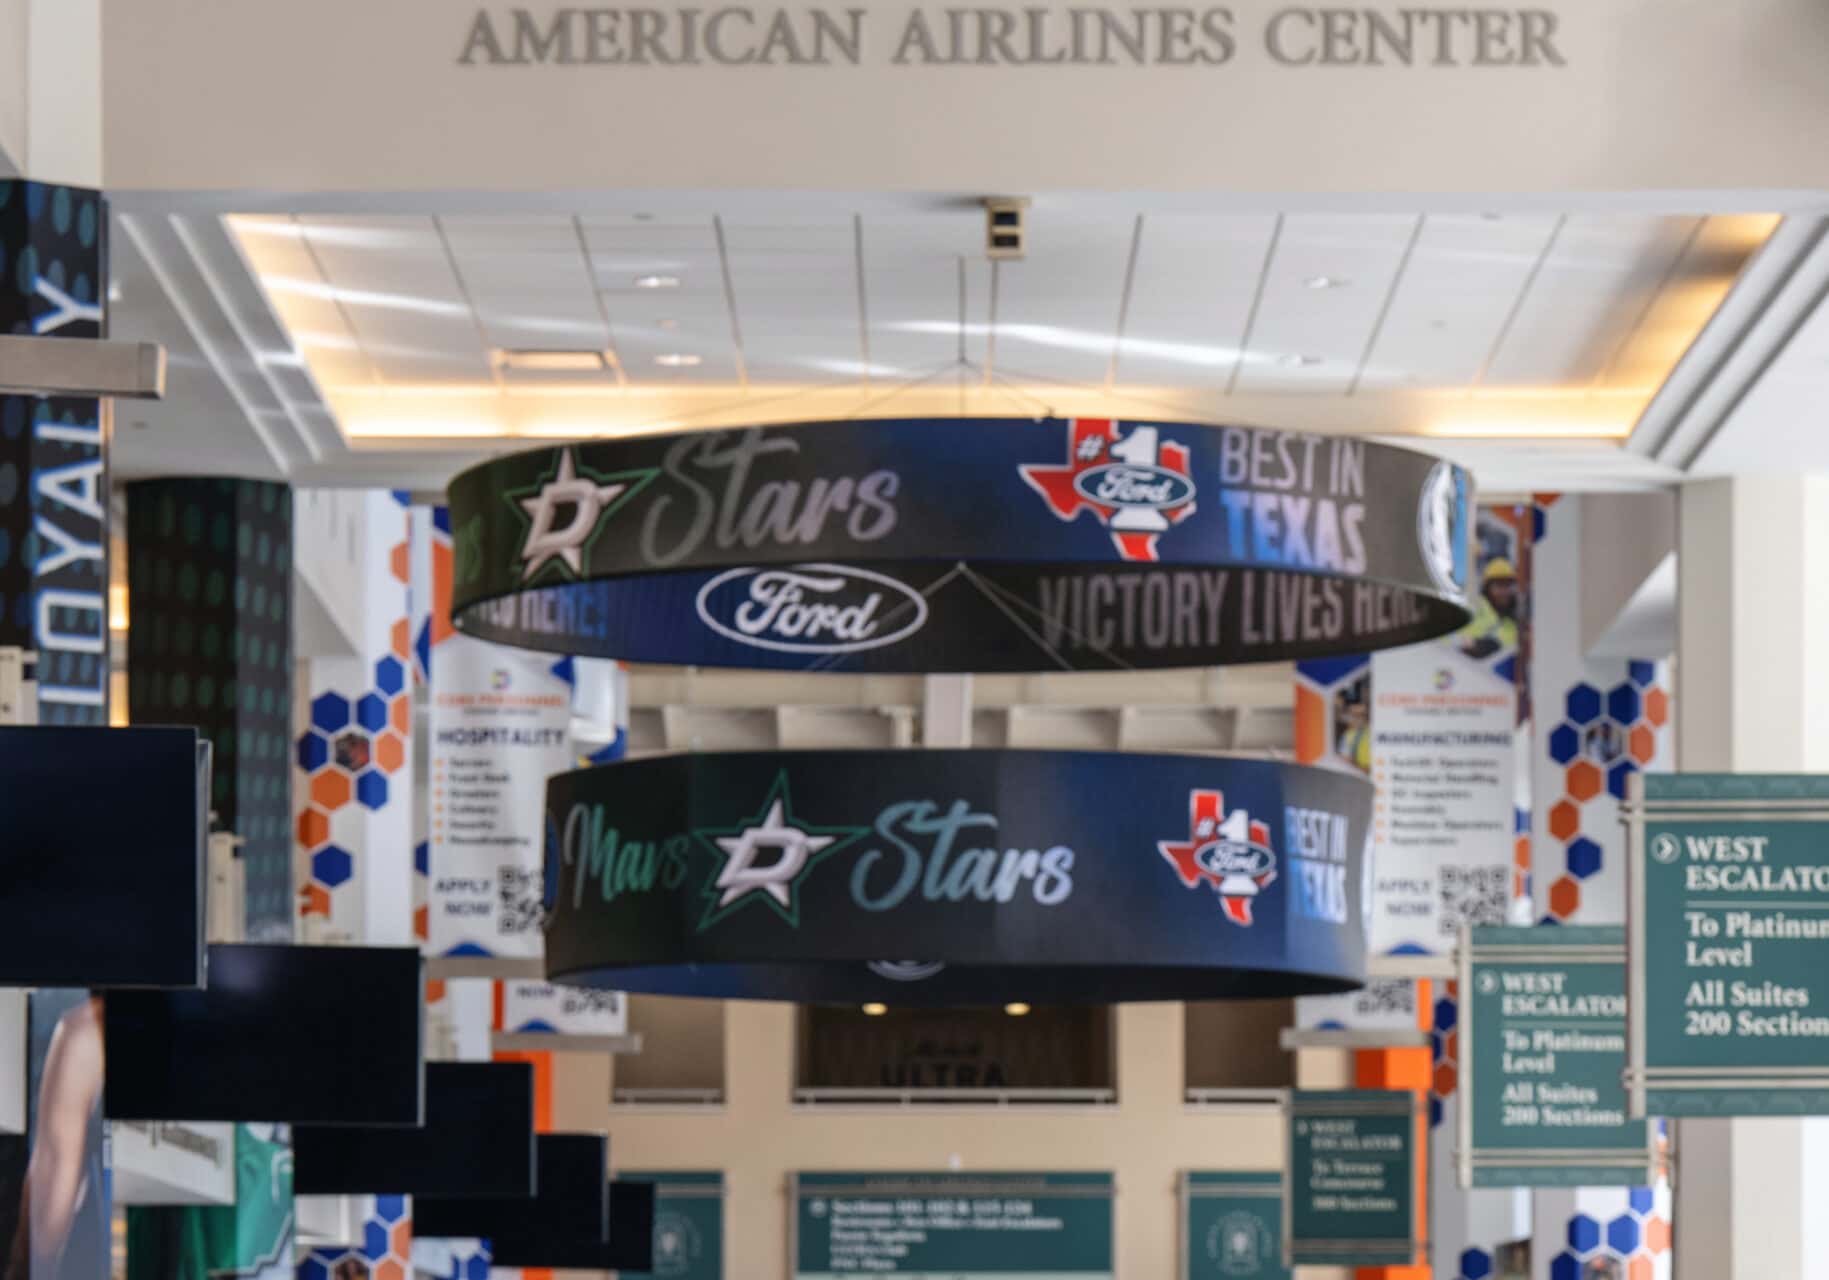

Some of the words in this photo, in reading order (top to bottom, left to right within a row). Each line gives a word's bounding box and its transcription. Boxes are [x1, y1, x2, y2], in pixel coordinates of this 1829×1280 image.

[456, 7, 861, 67] AMERICAN
[892, 7, 1235, 67] AIRLINES
[1265, 7, 1567, 67] CENTER
[1220, 426, 1318, 488] BEST
[1328, 437, 1365, 497] IN
[33, 272, 105, 706] LOYALY
[640, 427, 900, 567] Stars
[1097, 467, 1174, 502] Ford
[1219, 488, 1368, 577] TEXAS
[734, 572, 885, 641] Ford
[1038, 570, 1230, 650] VICTORY
[1241, 569, 1344, 642] LIVES
[436, 727, 566, 747] HOSPITALITY
[1376, 732, 1512, 748] MANUFACTURING
[563, 802, 691, 911] Mavs
[850, 799, 1075, 912] Stars
[1685, 835, 1769, 862] WEST
[435, 879, 491, 894] APPLY
[444, 903, 492, 917] NOW
[1684, 911, 1720, 938] To
[1685, 940, 1753, 967] Level
[1502, 972, 1567, 993] WEST
[1684, 980, 1725, 1007] All
[1730, 981, 1809, 1007] Suites
[1684, 1010, 1732, 1036] 200
[1502, 1029, 1529, 1051] To
[1532, 1029, 1624, 1051] Platinum
[1503, 1052, 1554, 1073] Level
[1502, 1082, 1533, 1104] All
[1537, 1082, 1598, 1104] Suites
[1541, 1104, 1624, 1126] Sections
